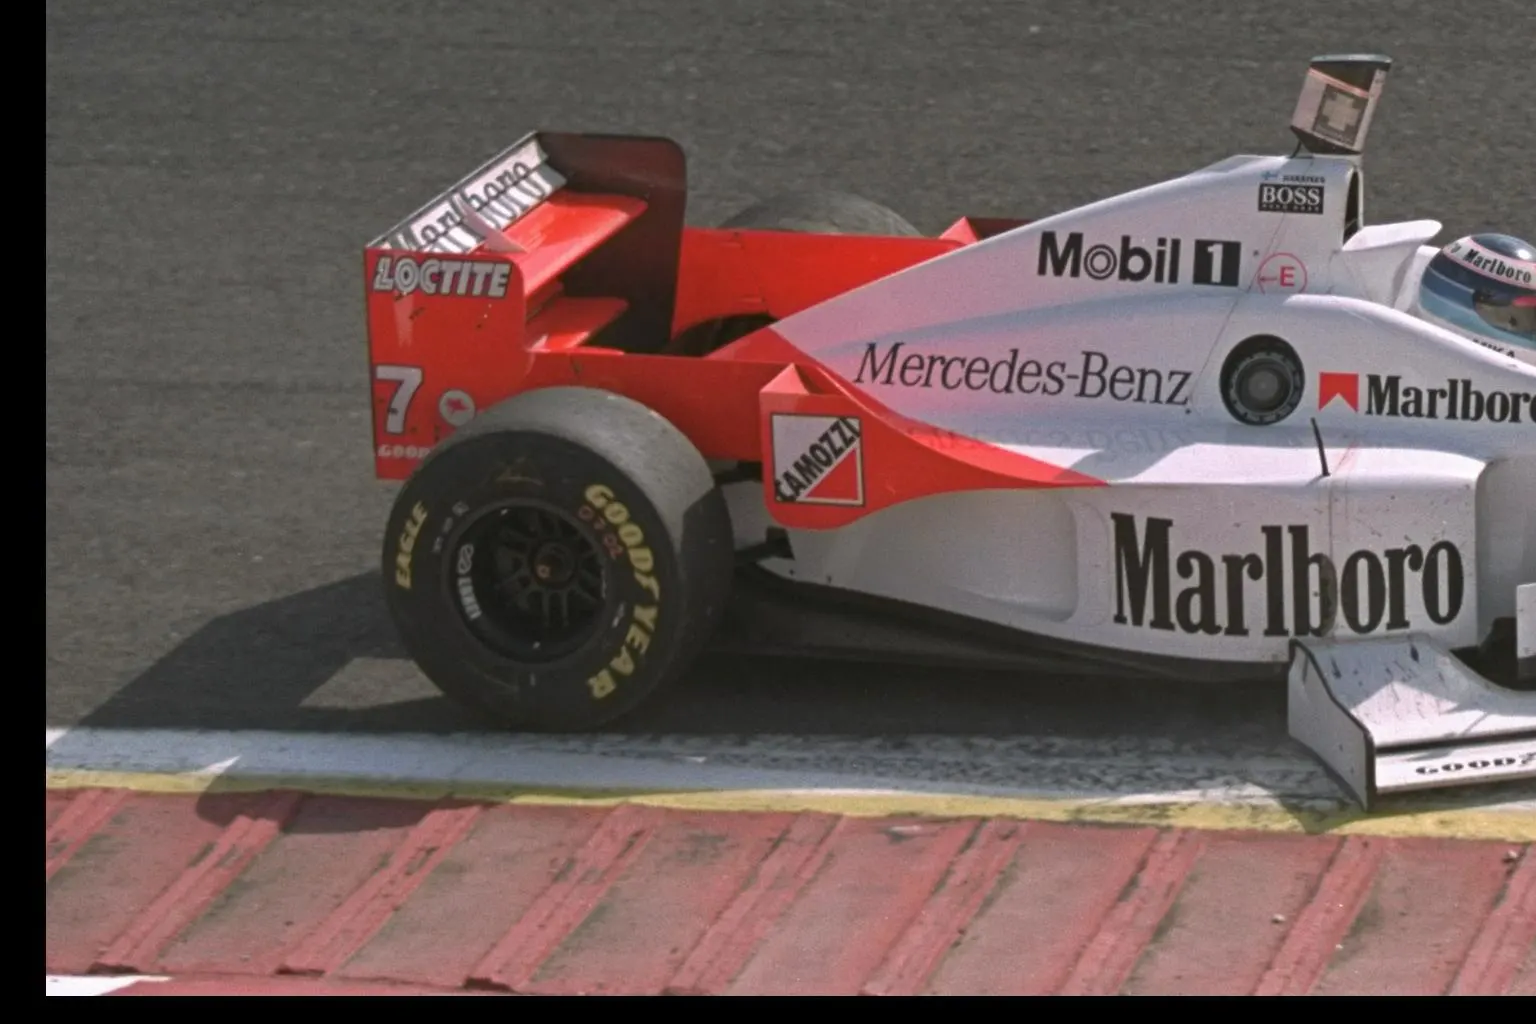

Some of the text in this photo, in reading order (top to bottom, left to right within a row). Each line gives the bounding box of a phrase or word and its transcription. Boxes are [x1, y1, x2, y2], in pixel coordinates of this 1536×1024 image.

[1262, 186, 1320, 206] BOSS
[373, 256, 512, 299] LOCTITE
[1037, 230, 1181, 285] Mobil
[1280, 266, 1296, 288] E
[1463, 248, 1532, 284] Marlboro
[375, 363, 424, 434] 7
[852, 342, 1194, 408] Mercedes-Benz
[775, 417, 861, 501] CAMOZZI
[395, 500, 428, 590] EAGLE
[1110, 511, 1465, 638] Marlboro
